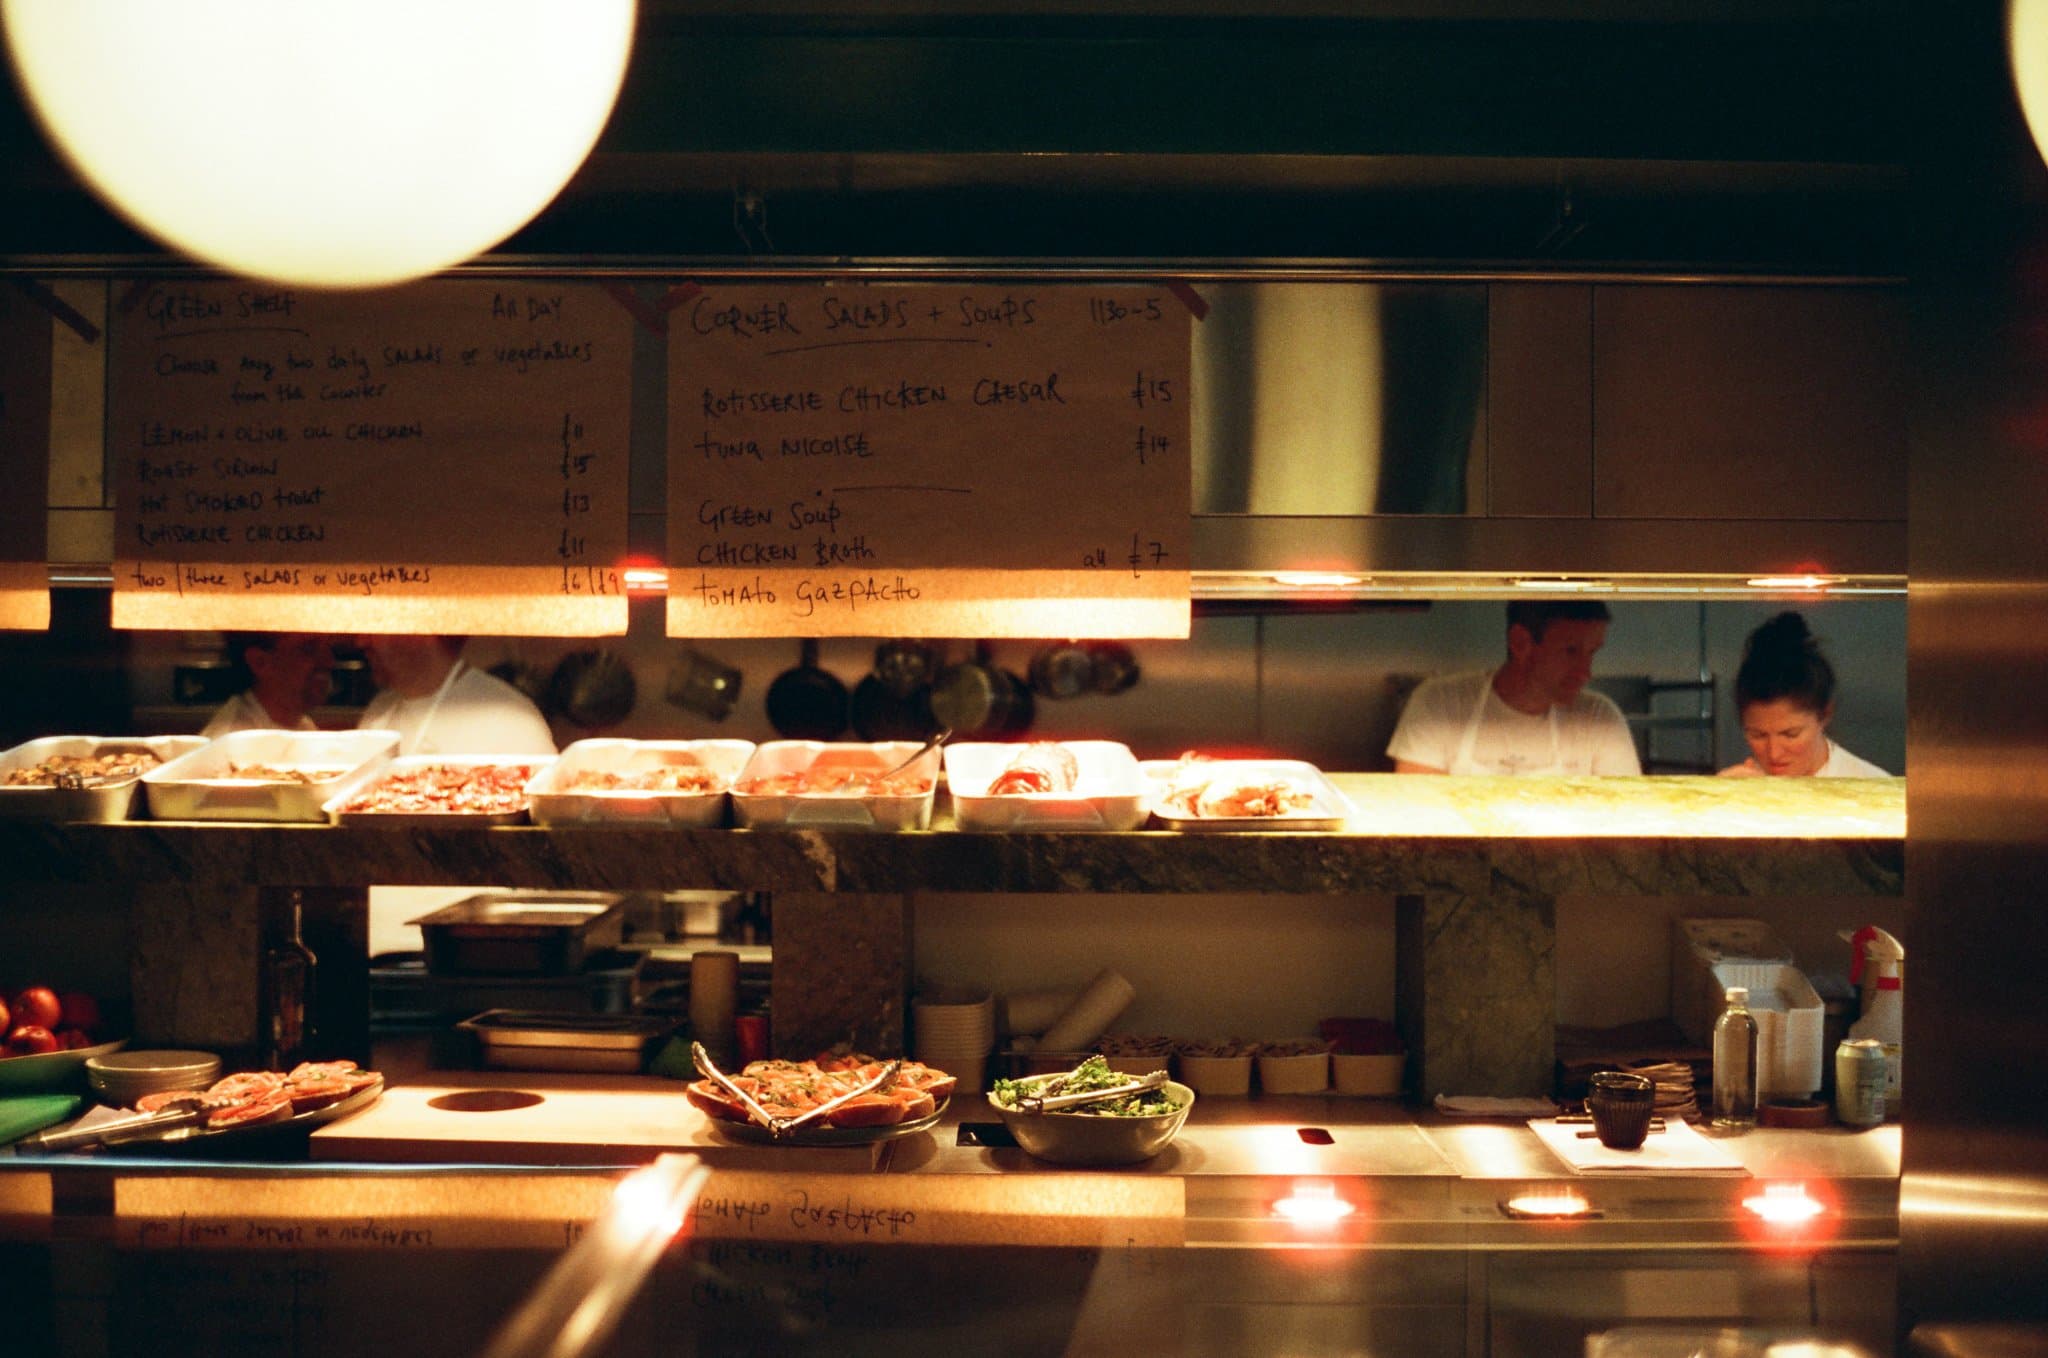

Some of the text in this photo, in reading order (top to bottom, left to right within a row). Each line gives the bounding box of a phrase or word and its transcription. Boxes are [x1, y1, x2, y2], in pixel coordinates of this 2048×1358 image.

[691, 297, 801, 338] CORNER
[823, 297, 909, 329] SALADS
[928, 306, 944, 323] +
[839, 380, 948, 413] CHICKEN
[1131, 370, 1173, 409] £15
[1135, 425, 1171, 465] £14
[697, 540, 798, 567] CHICKEN
[313, 572, 328, 587] or
